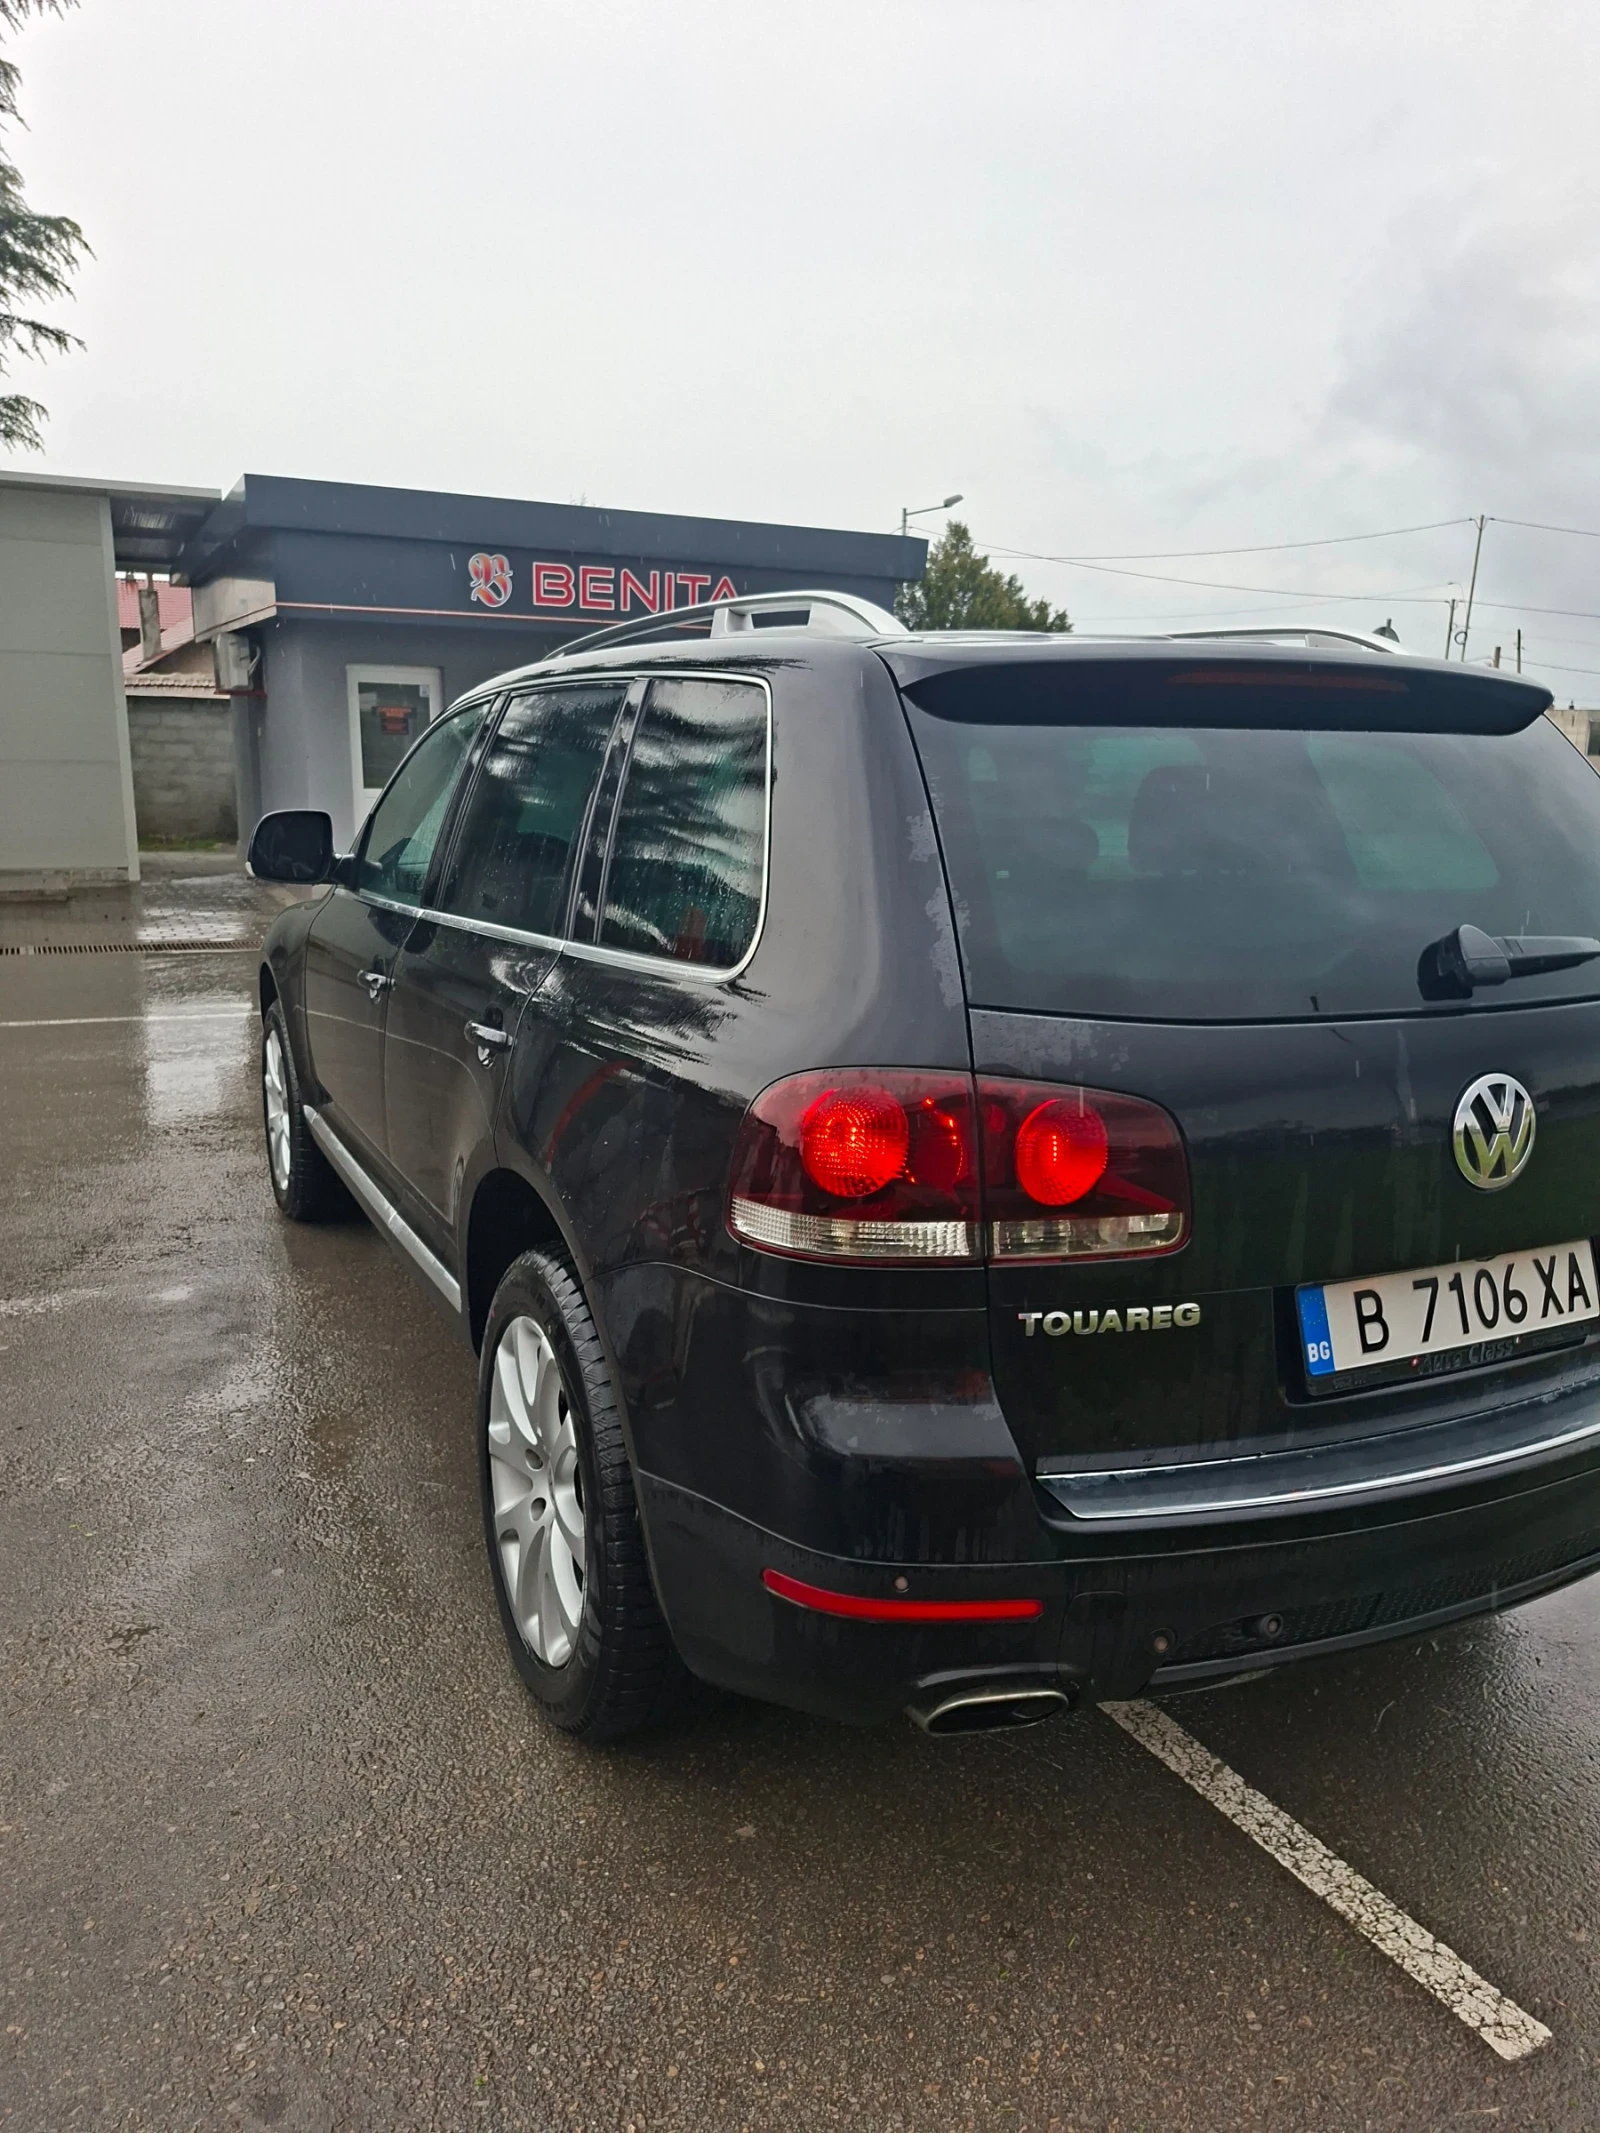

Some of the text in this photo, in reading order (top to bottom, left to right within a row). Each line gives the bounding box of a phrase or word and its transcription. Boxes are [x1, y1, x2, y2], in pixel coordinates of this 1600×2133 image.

[532, 561, 738, 614] BENITA
[1018, 1302, 1201, 1337] TOUAREG
[1353, 1251, 1592, 1354] B 7106 XA
[1306, 1340, 1331, 1363] BG
[1467, 1339, 1514, 1365] Class
